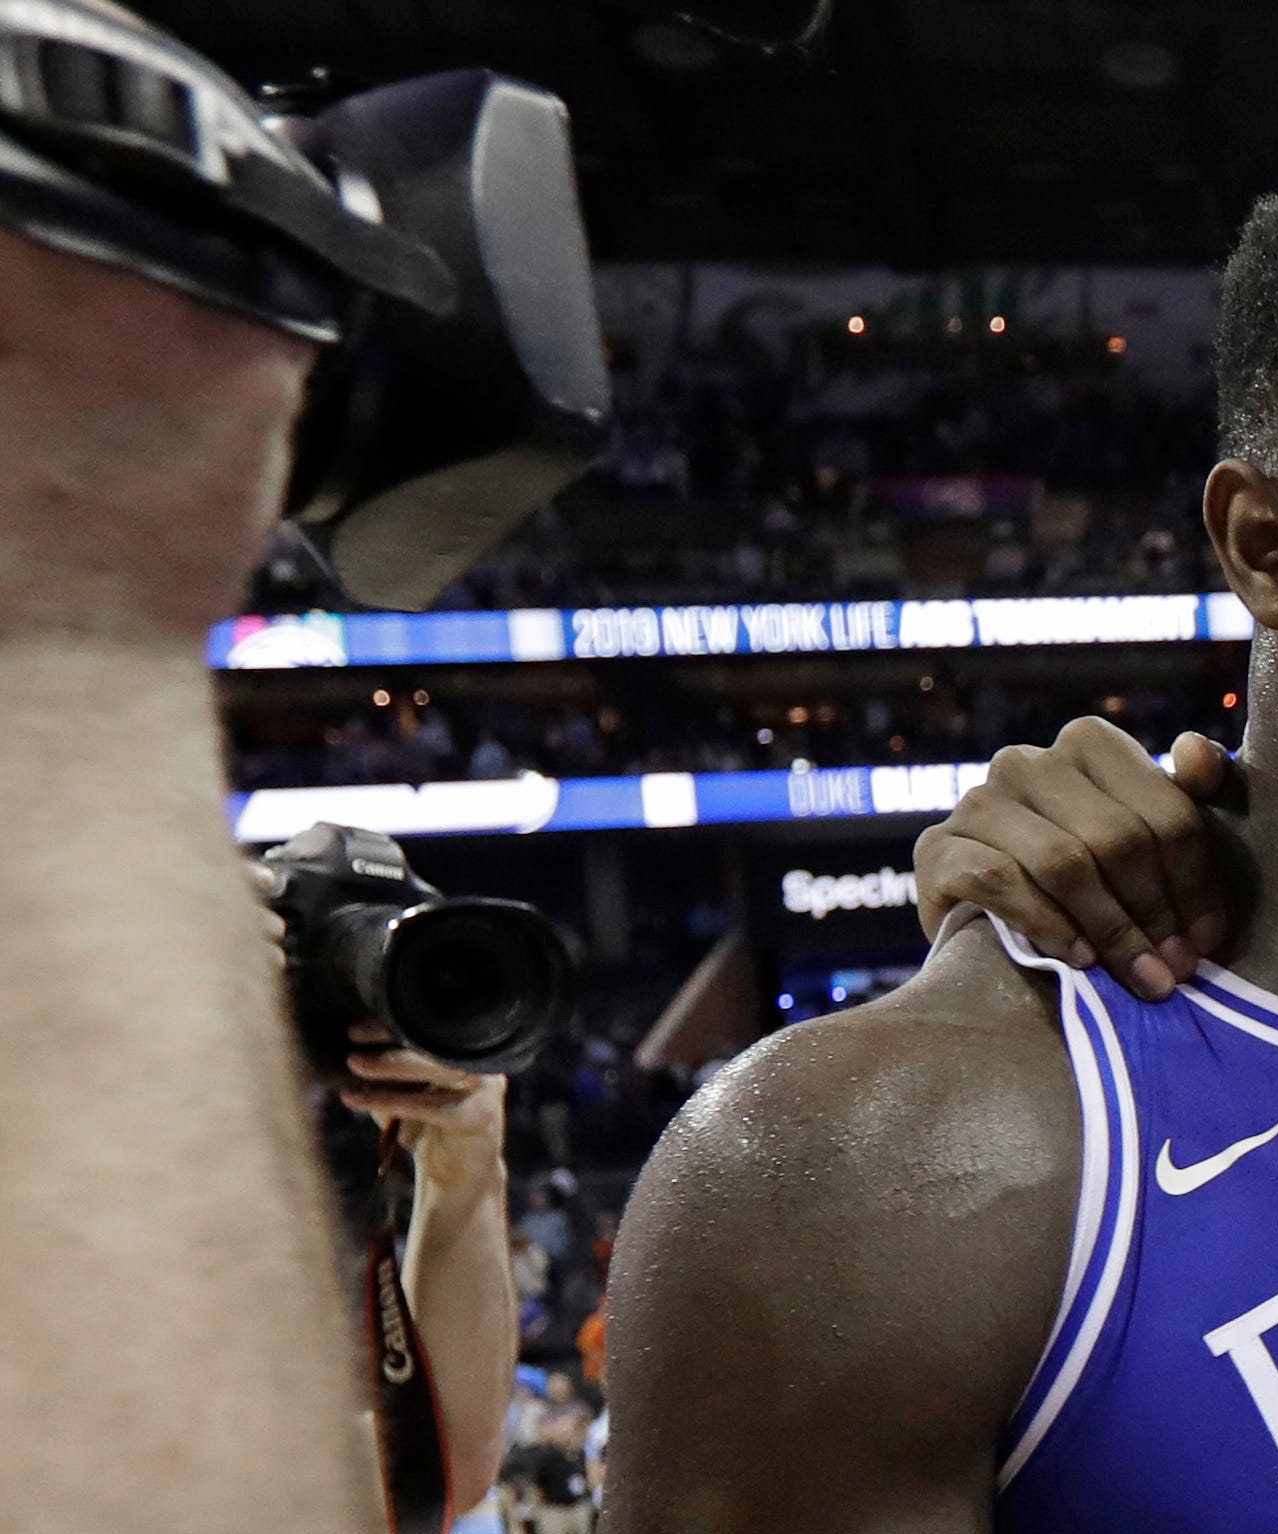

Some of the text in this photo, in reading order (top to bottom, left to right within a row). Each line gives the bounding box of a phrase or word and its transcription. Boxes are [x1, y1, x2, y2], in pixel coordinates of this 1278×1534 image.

[661, 605, 738, 656] NEW
[741, 603, 829, 654] YORK
[829, 601, 897, 649] LIFE
[788, 768, 868, 817] DUKE
[352, 858, 405, 881] Canon
[377, 1258, 415, 1385] Canon
